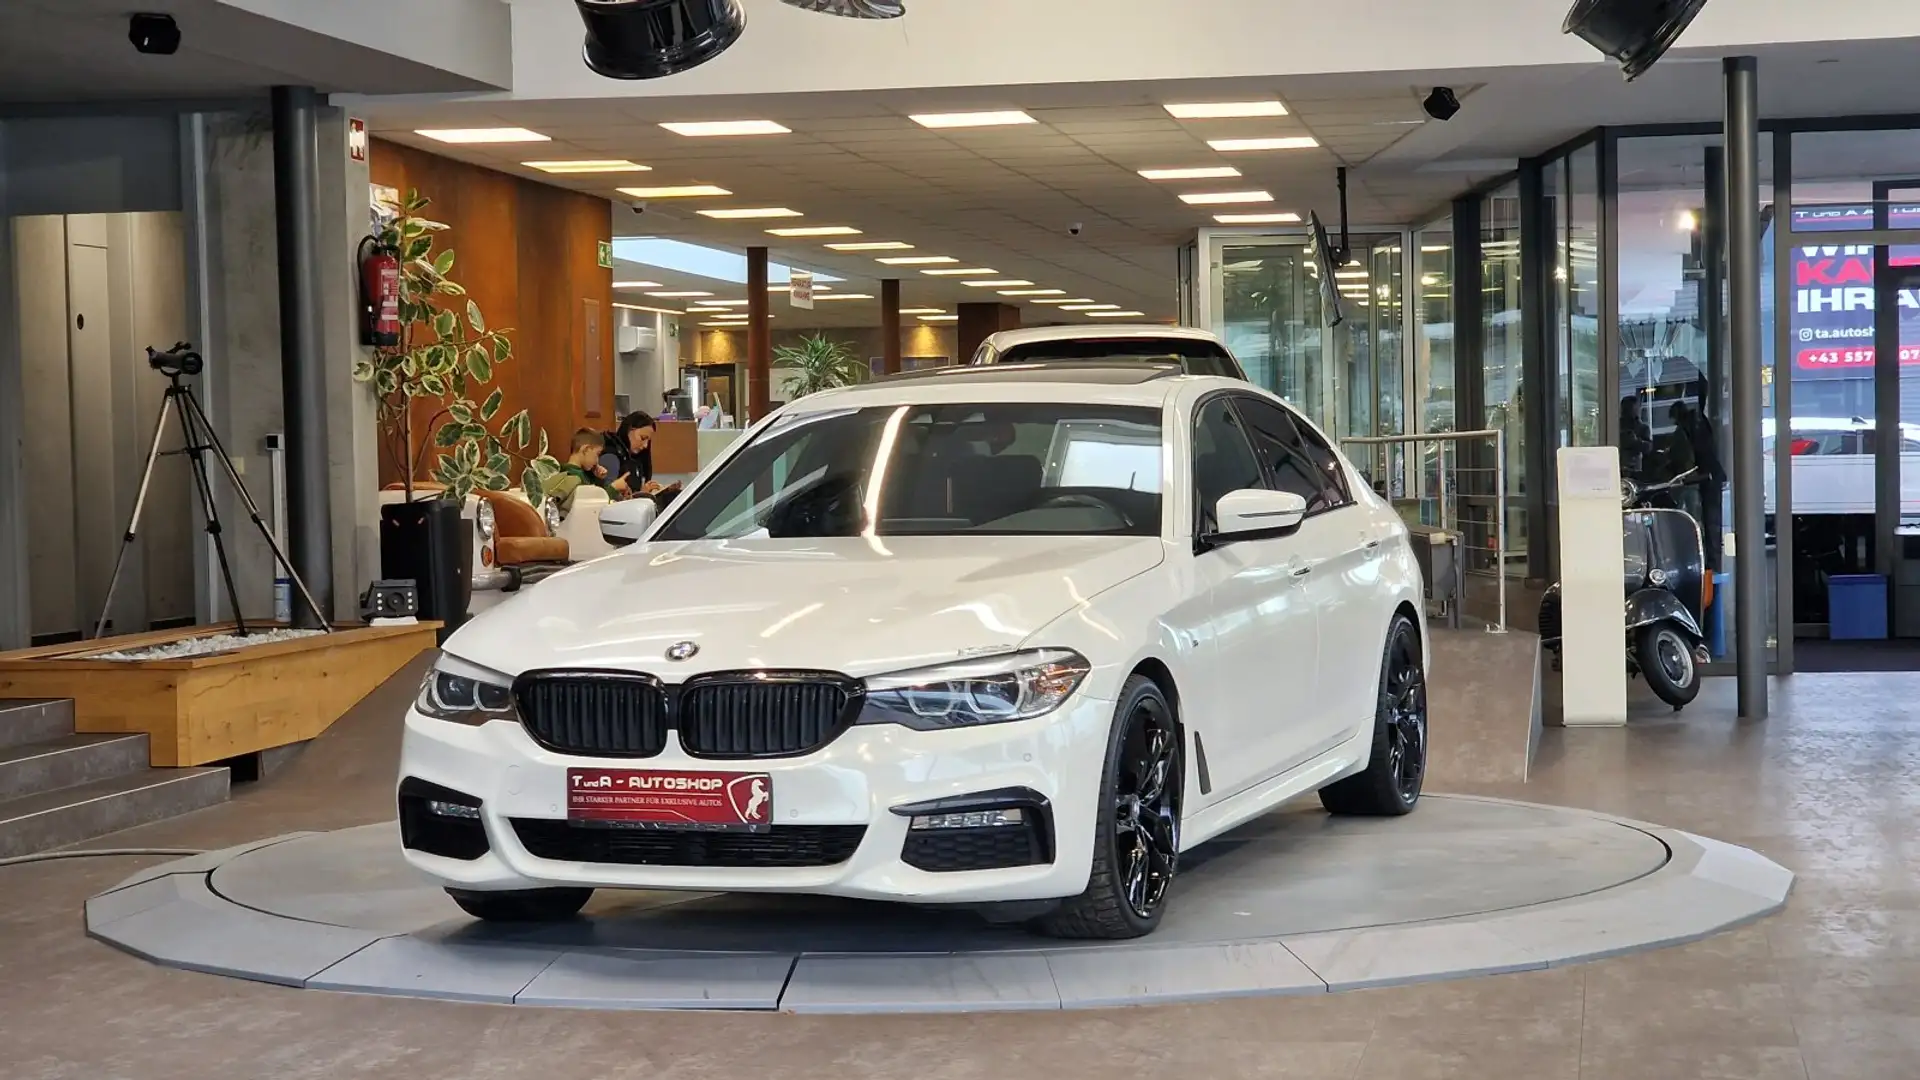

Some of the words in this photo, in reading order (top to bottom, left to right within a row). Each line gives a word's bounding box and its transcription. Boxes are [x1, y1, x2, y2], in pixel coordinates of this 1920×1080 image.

[1809, 352, 1838, 363] +43
[629, 776, 723, 790] AUTOSHOP
[586, 795, 614, 804] STARKER
[661, 798, 697, 806] EXKLUSIVE
[699, 799, 723, 807] AUTOS
